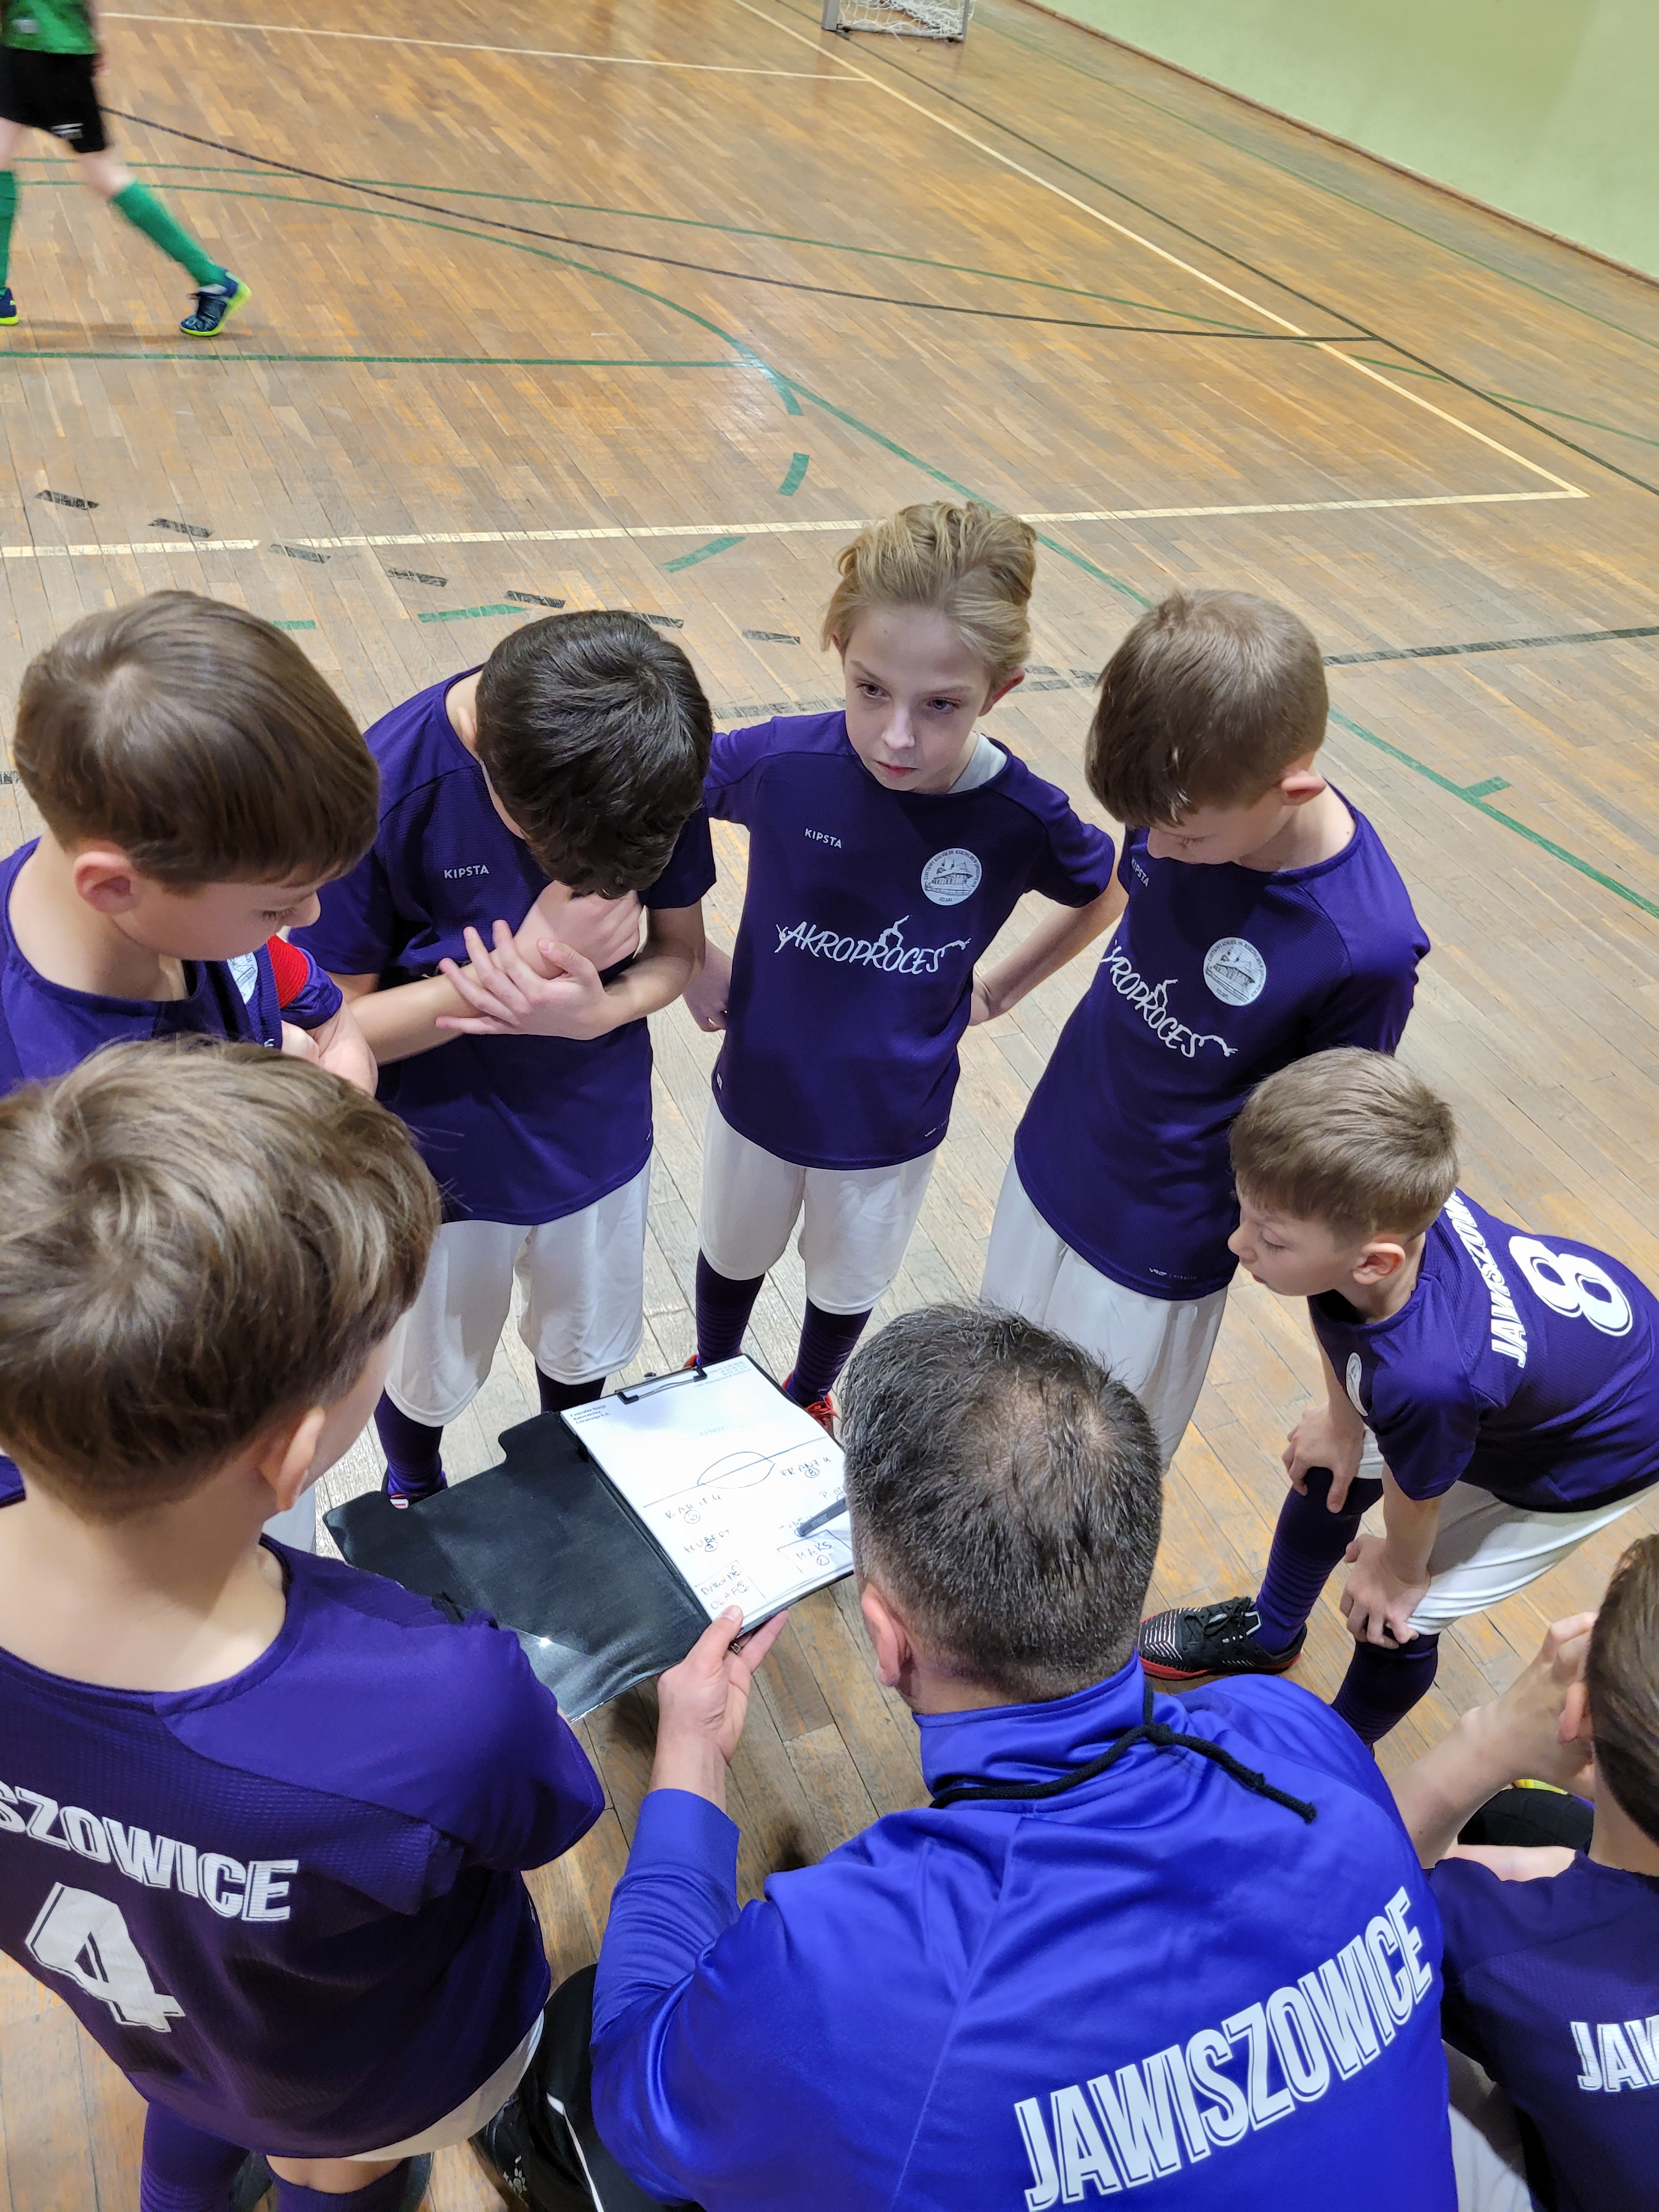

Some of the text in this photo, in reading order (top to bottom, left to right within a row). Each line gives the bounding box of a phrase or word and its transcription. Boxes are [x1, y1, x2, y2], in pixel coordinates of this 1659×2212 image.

[444, 865, 489, 879] KIPSTA
[804, 828, 842, 849] KIPSTA
[788, 922, 945, 974] AKROPROCES
[1509, 1235, 1633, 1338] 8
[25, 1882, 185, 2033] 4
[1014, 1886, 1433, 2212] JAWISZOWICE
